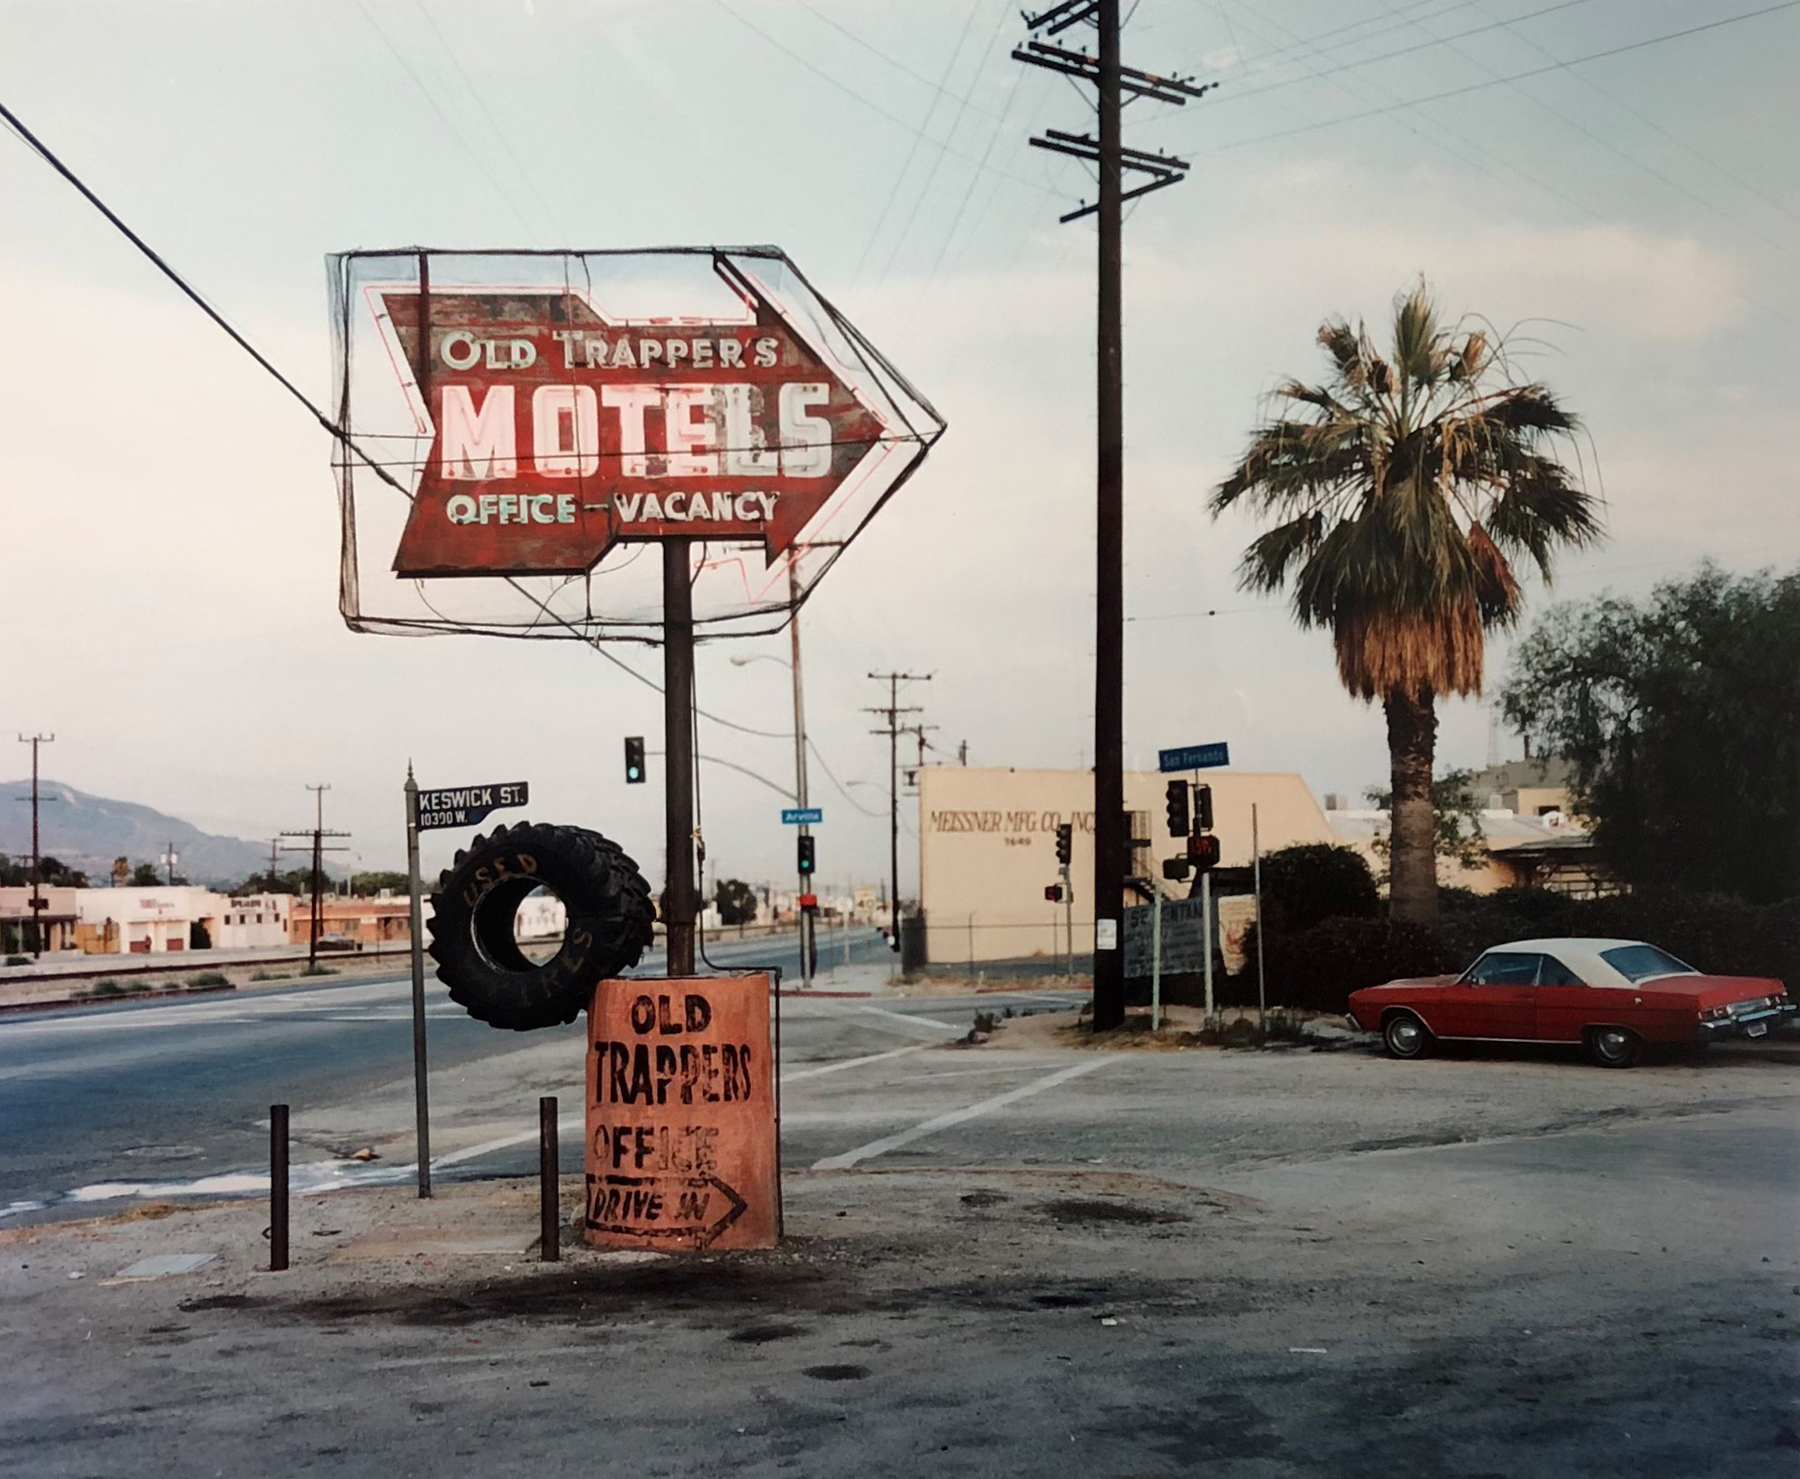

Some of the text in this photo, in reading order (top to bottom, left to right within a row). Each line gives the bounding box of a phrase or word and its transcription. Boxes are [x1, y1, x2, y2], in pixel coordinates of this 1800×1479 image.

[440, 330, 779, 370] OLD TRAPPER'S
[440, 382, 833, 478] MOTELS
[446, 494, 575, 525] OFFICE
[613, 491, 781, 523] VACANCY
[420, 786, 524, 811] KESWICK ST.
[929, 811, 1002, 833] MEISSNER
[463, 852, 539, 907] USED
[631, 994, 712, 1036] OLD
[594, 1041, 752, 1105] TRAPPERS
[594, 1124, 720, 1172] OFFICE
[592, 1187, 711, 1222] DRIVE IN
